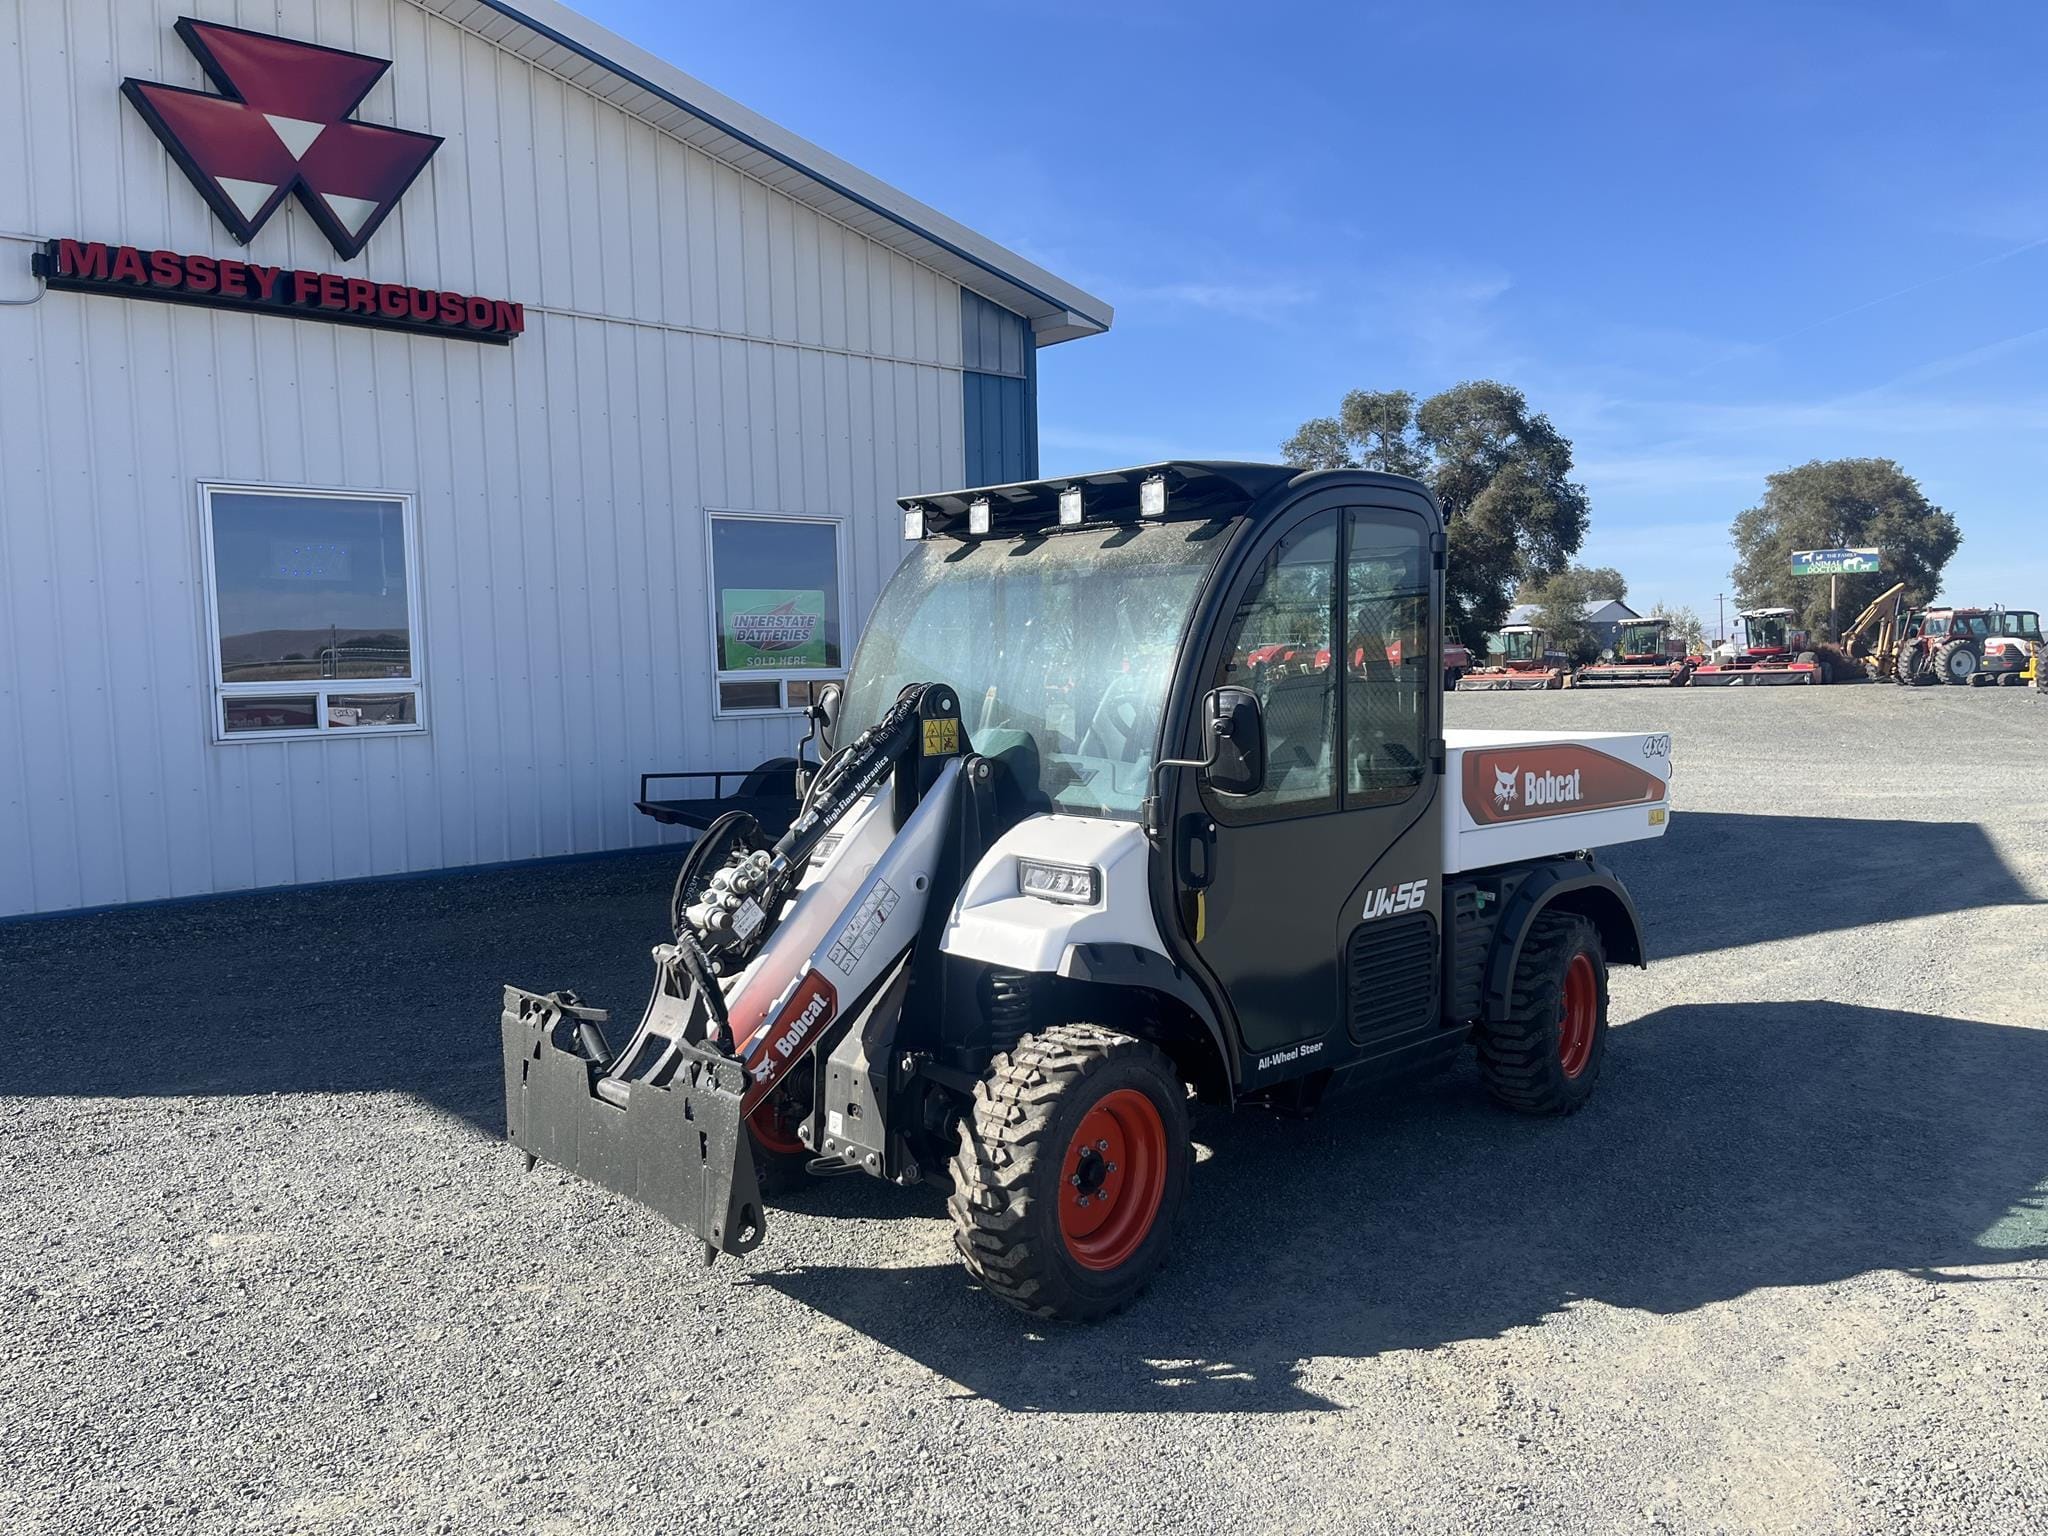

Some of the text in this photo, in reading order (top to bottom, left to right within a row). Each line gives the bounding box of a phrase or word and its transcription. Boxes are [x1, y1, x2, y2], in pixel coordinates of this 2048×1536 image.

[59, 238, 524, 333] MASSEY FERGUSON
[1807, 566, 1842, 574] DOCTOR
[733, 615, 817, 628] INTERSTATE
[735, 629, 811, 642] BATTERIES
[747, 656, 808, 666] SOLD HERE
[1643, 735, 1668, 758] 4x4
[823, 805, 841, 827] High
[839, 790, 857, 810] Flow
[855, 755, 889, 792] Hydraulics
[1524, 768, 1581, 807] Bobcat
[774, 992, 827, 1058] Bobcat
[1257, 1042, 1323, 1070] All-Wheel Steer
